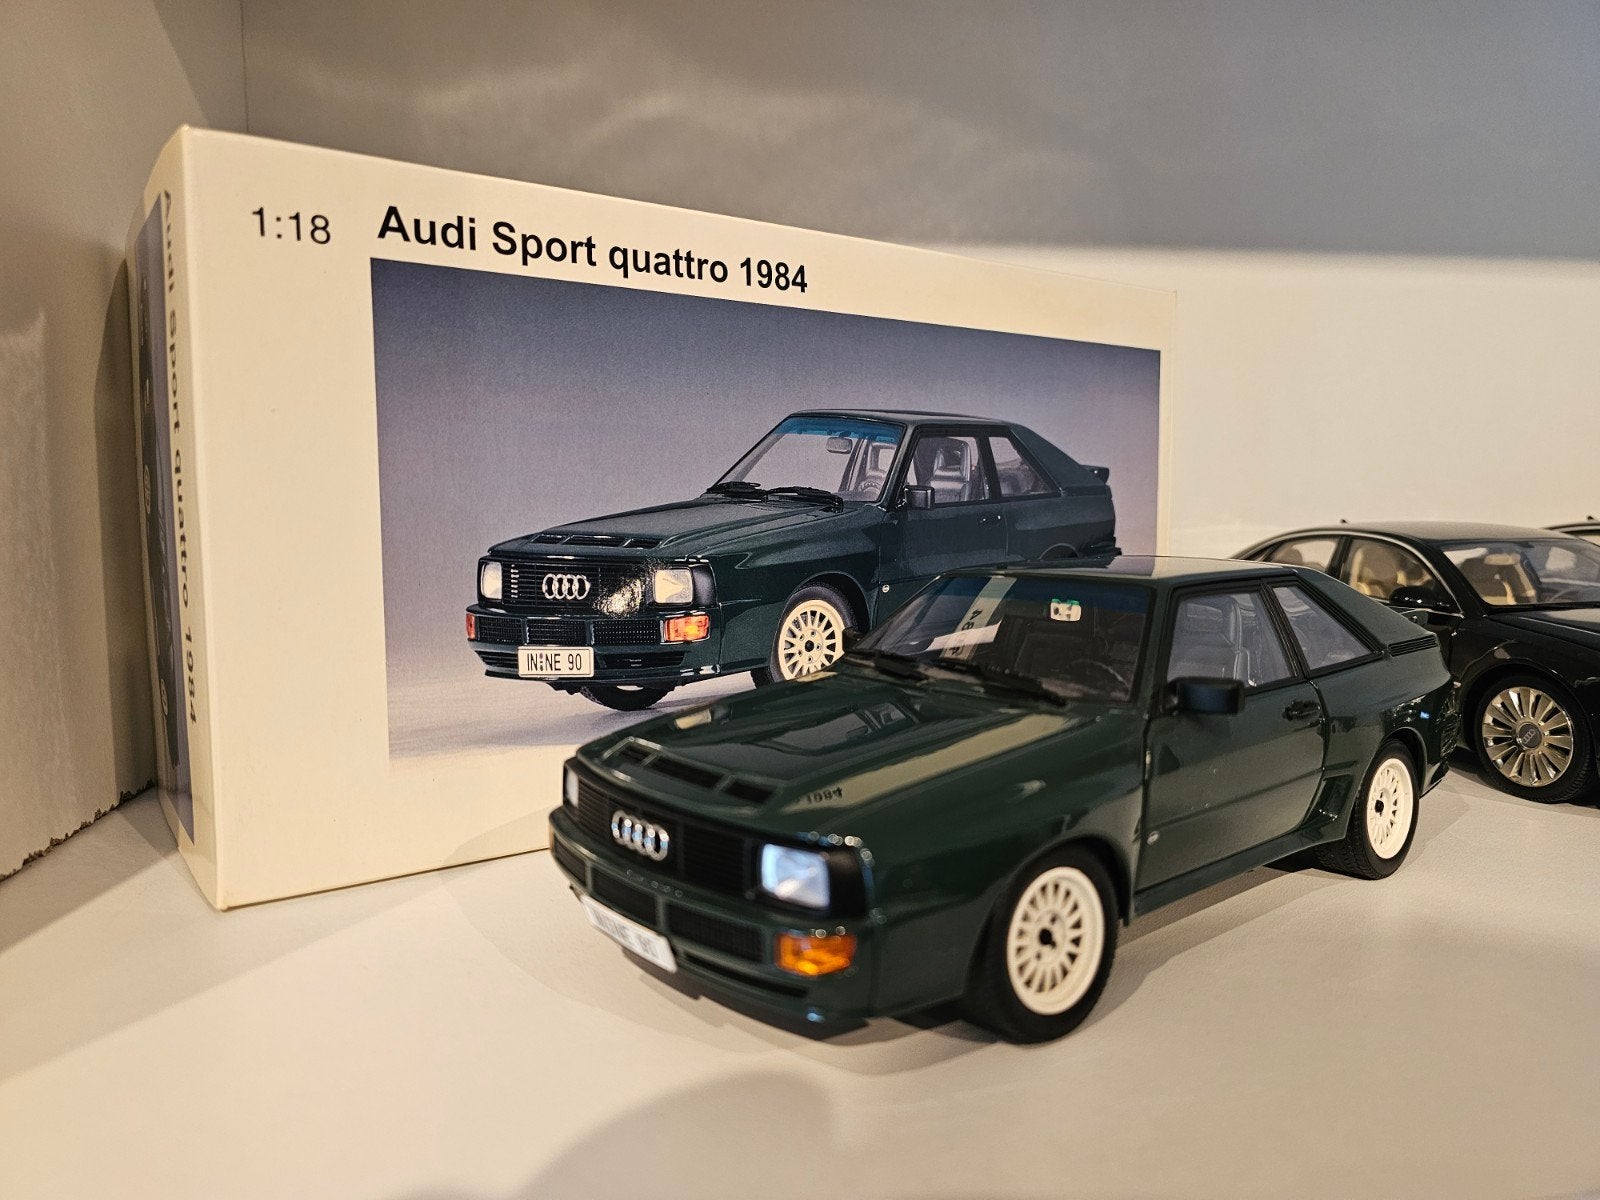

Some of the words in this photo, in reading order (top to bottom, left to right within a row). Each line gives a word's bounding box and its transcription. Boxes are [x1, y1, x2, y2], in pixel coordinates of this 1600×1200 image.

[164, 190, 176, 293] Audi
[252, 206, 331, 245] 1:18
[377, 205, 477, 251] Audi
[492, 221, 597, 266] Sport
[609, 245, 729, 283] quattro
[740, 257, 808, 293] 1984
[169, 309, 181, 434] Sport
[175, 449, 189, 608] quattro
[185, 626, 197, 723] 1984
[568, 653, 582, 671] 90
